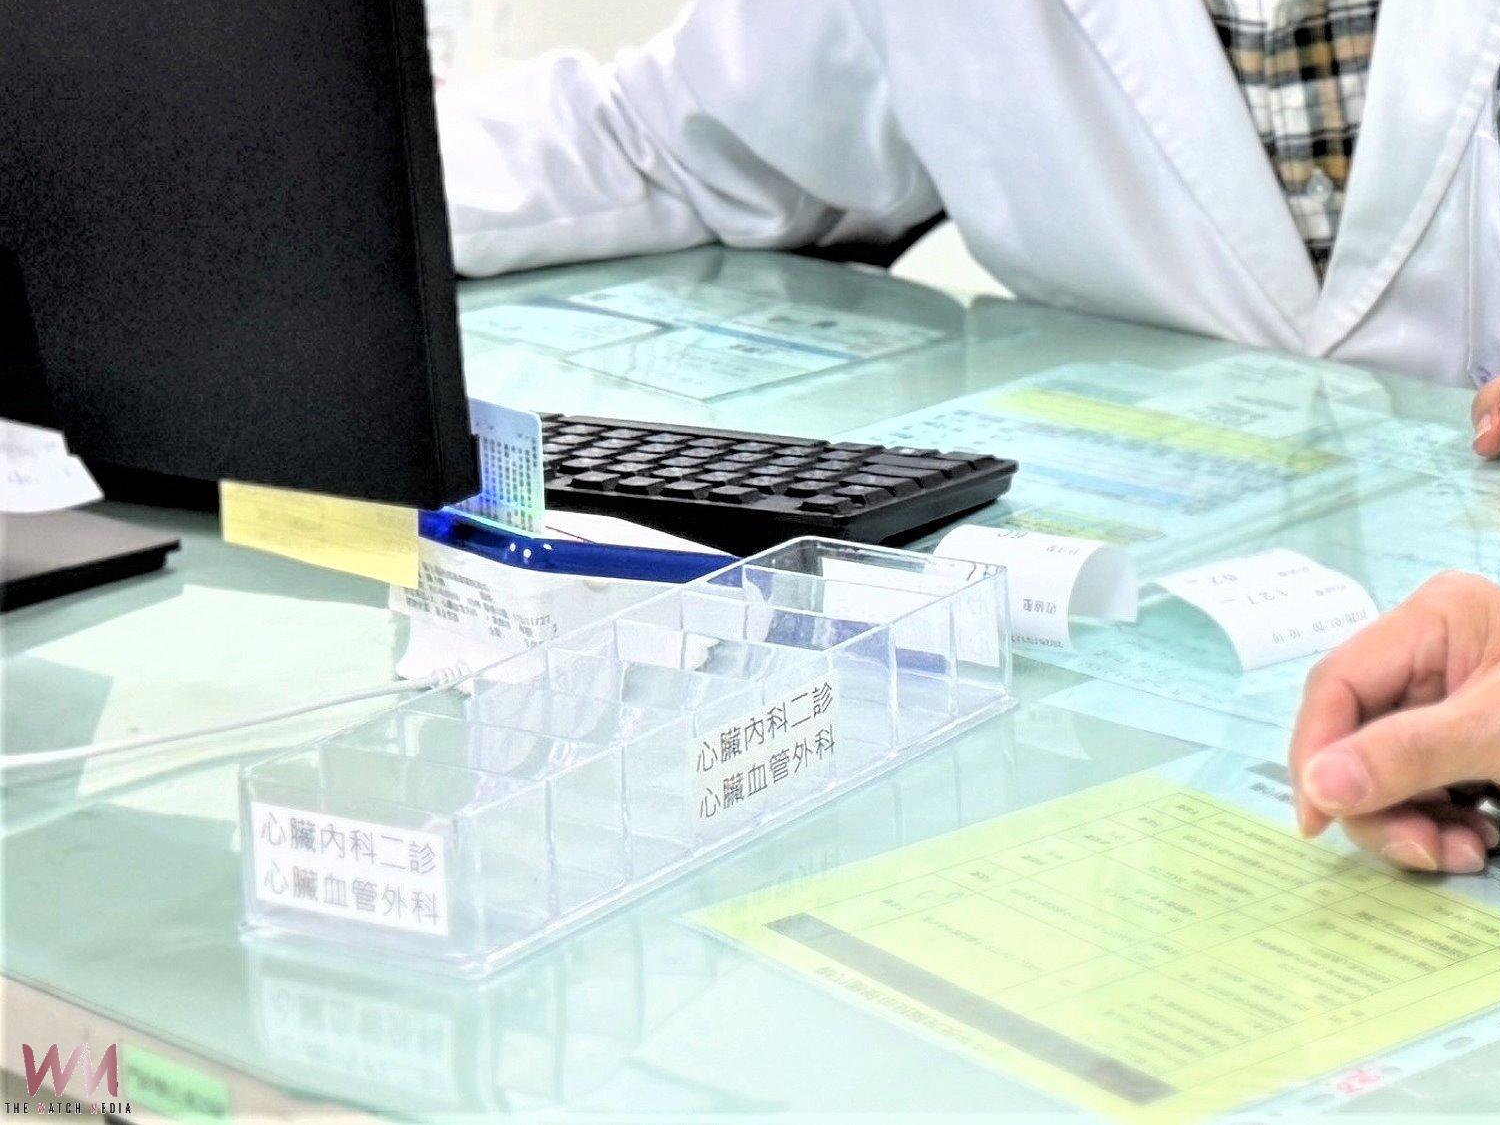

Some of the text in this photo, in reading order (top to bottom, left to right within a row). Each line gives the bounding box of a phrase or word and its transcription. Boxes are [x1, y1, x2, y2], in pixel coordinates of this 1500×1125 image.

[697, 682, 833, 772] 心臟內科二診
[700, 724, 835, 818] 心臟血管外科
[261, 812, 436, 874] 心臟內科二診
[264, 860, 439, 925] 心臟血管外科
